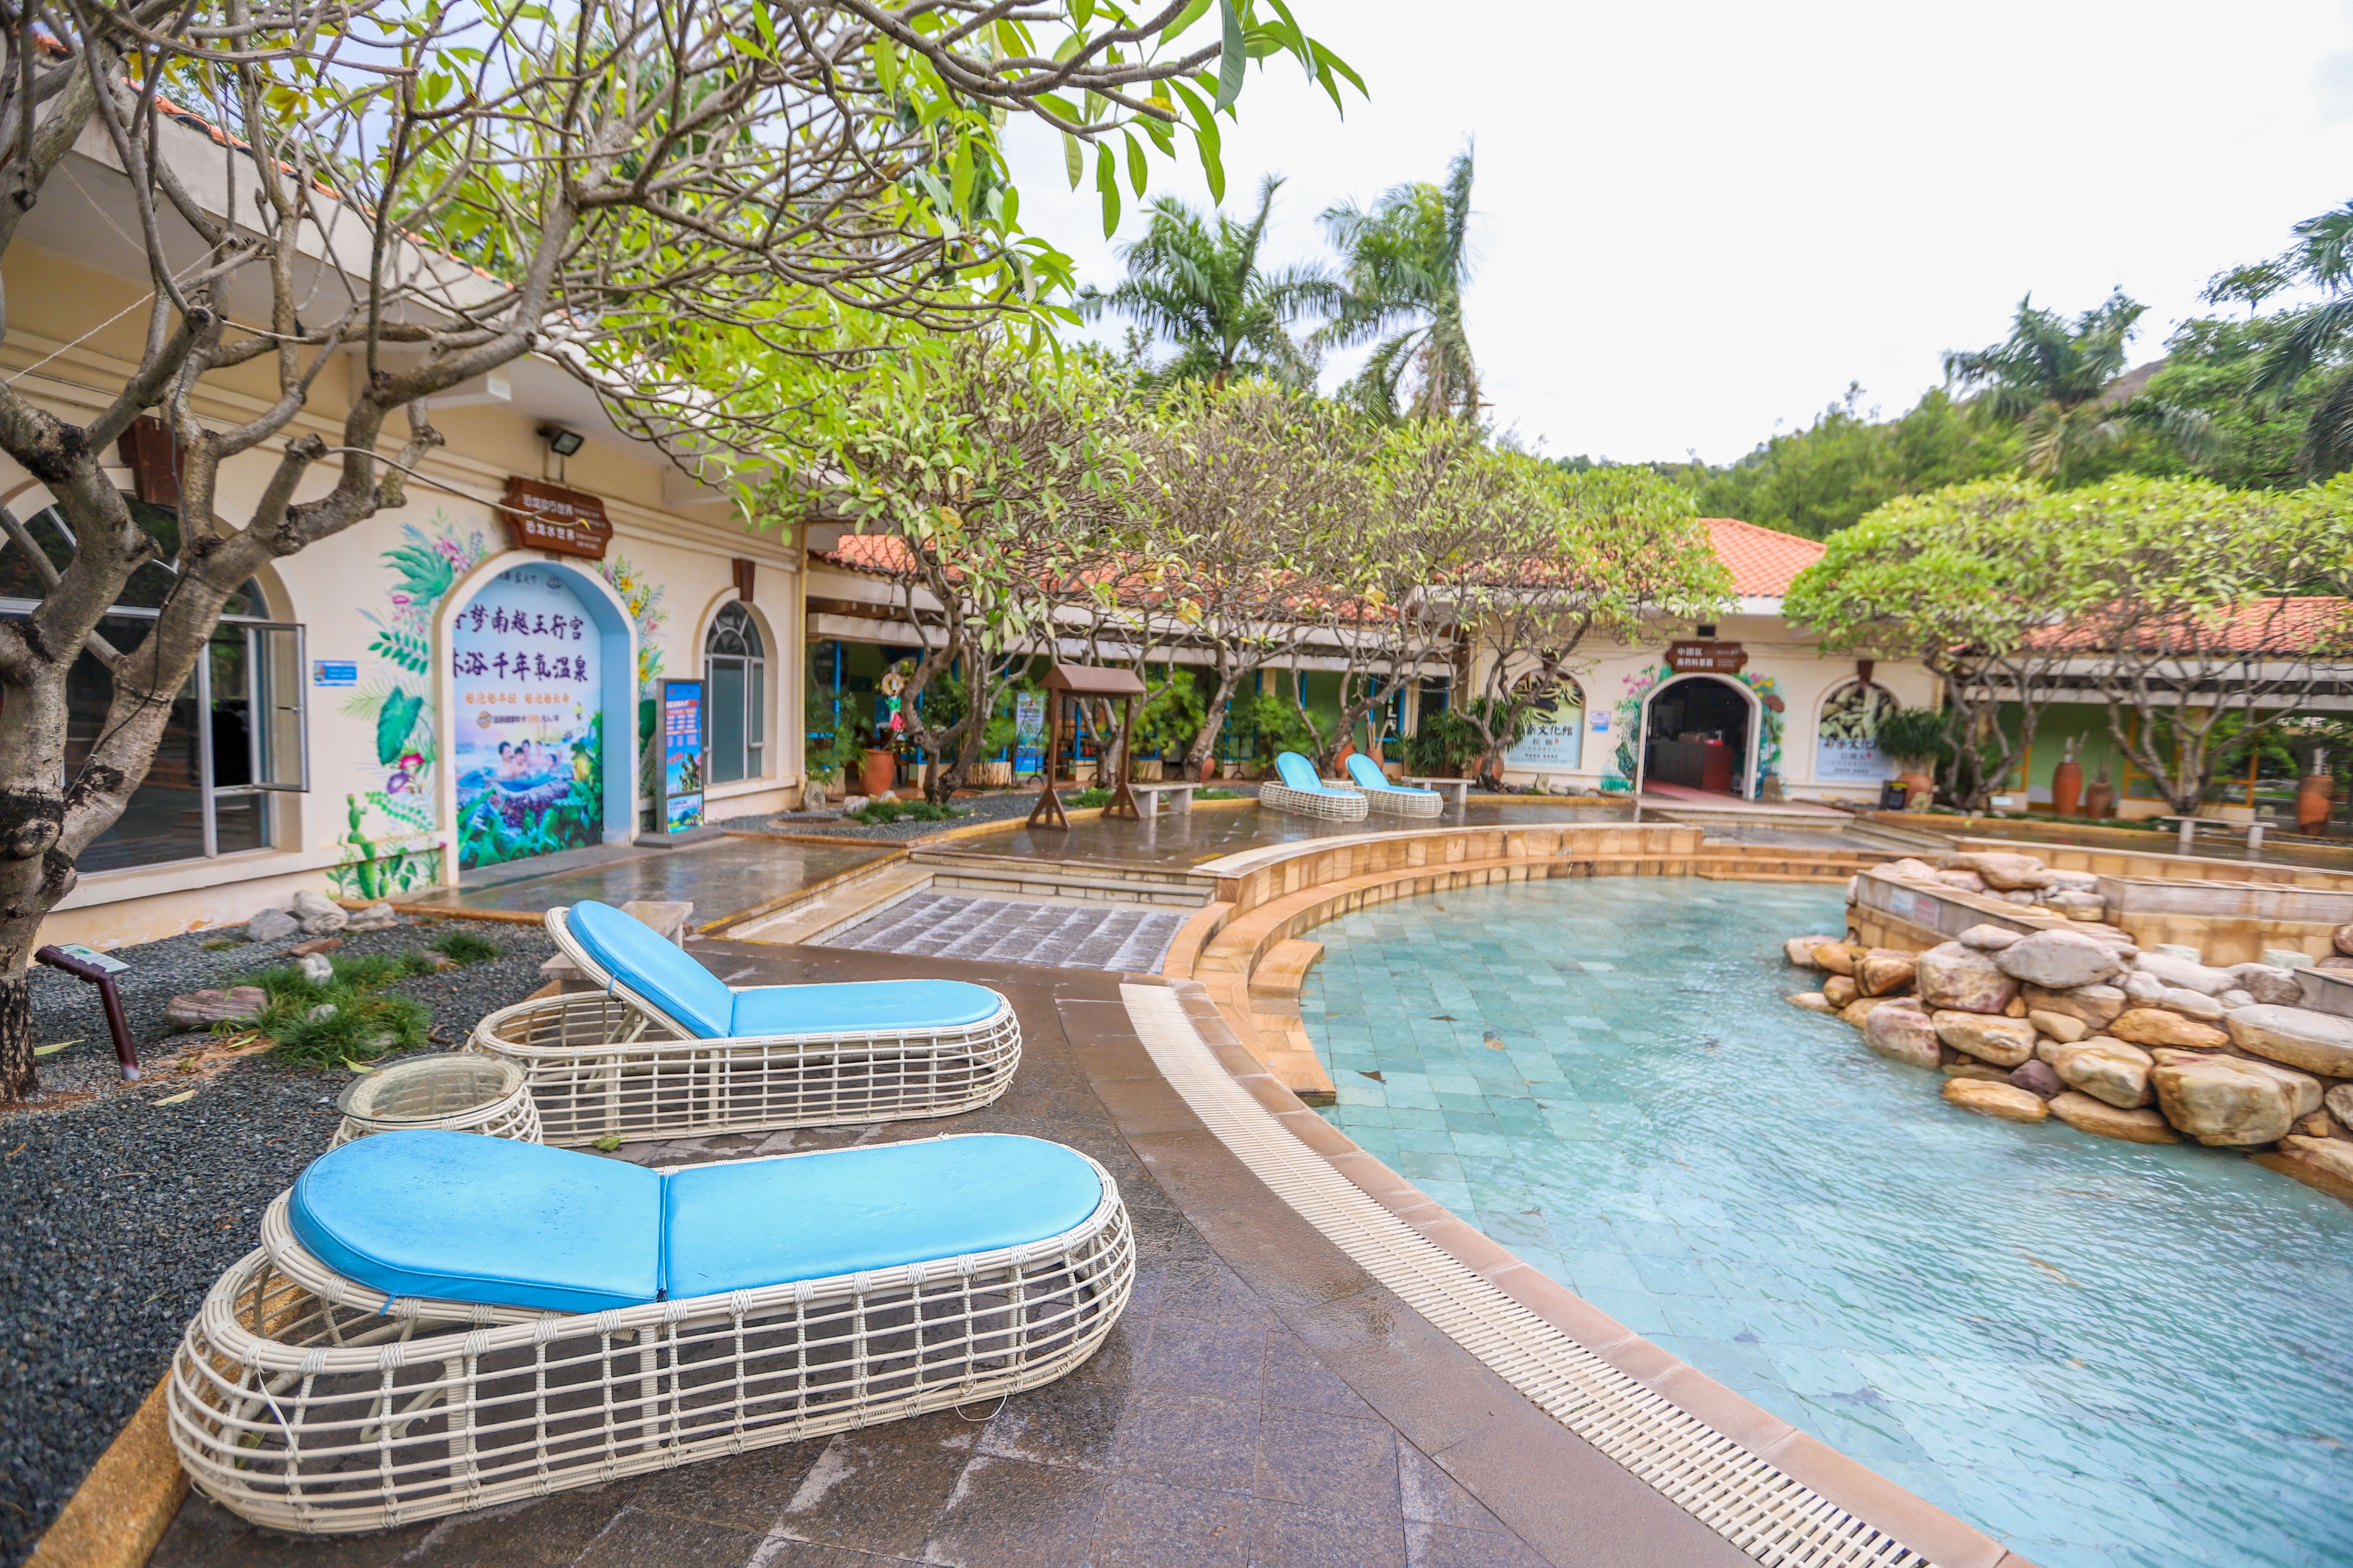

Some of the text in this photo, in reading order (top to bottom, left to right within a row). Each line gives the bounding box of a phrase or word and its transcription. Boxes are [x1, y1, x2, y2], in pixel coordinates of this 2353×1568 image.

[526, 520, 575, 540] 恐龙水世界
[1677, 647, 1703, 656] 中国区
